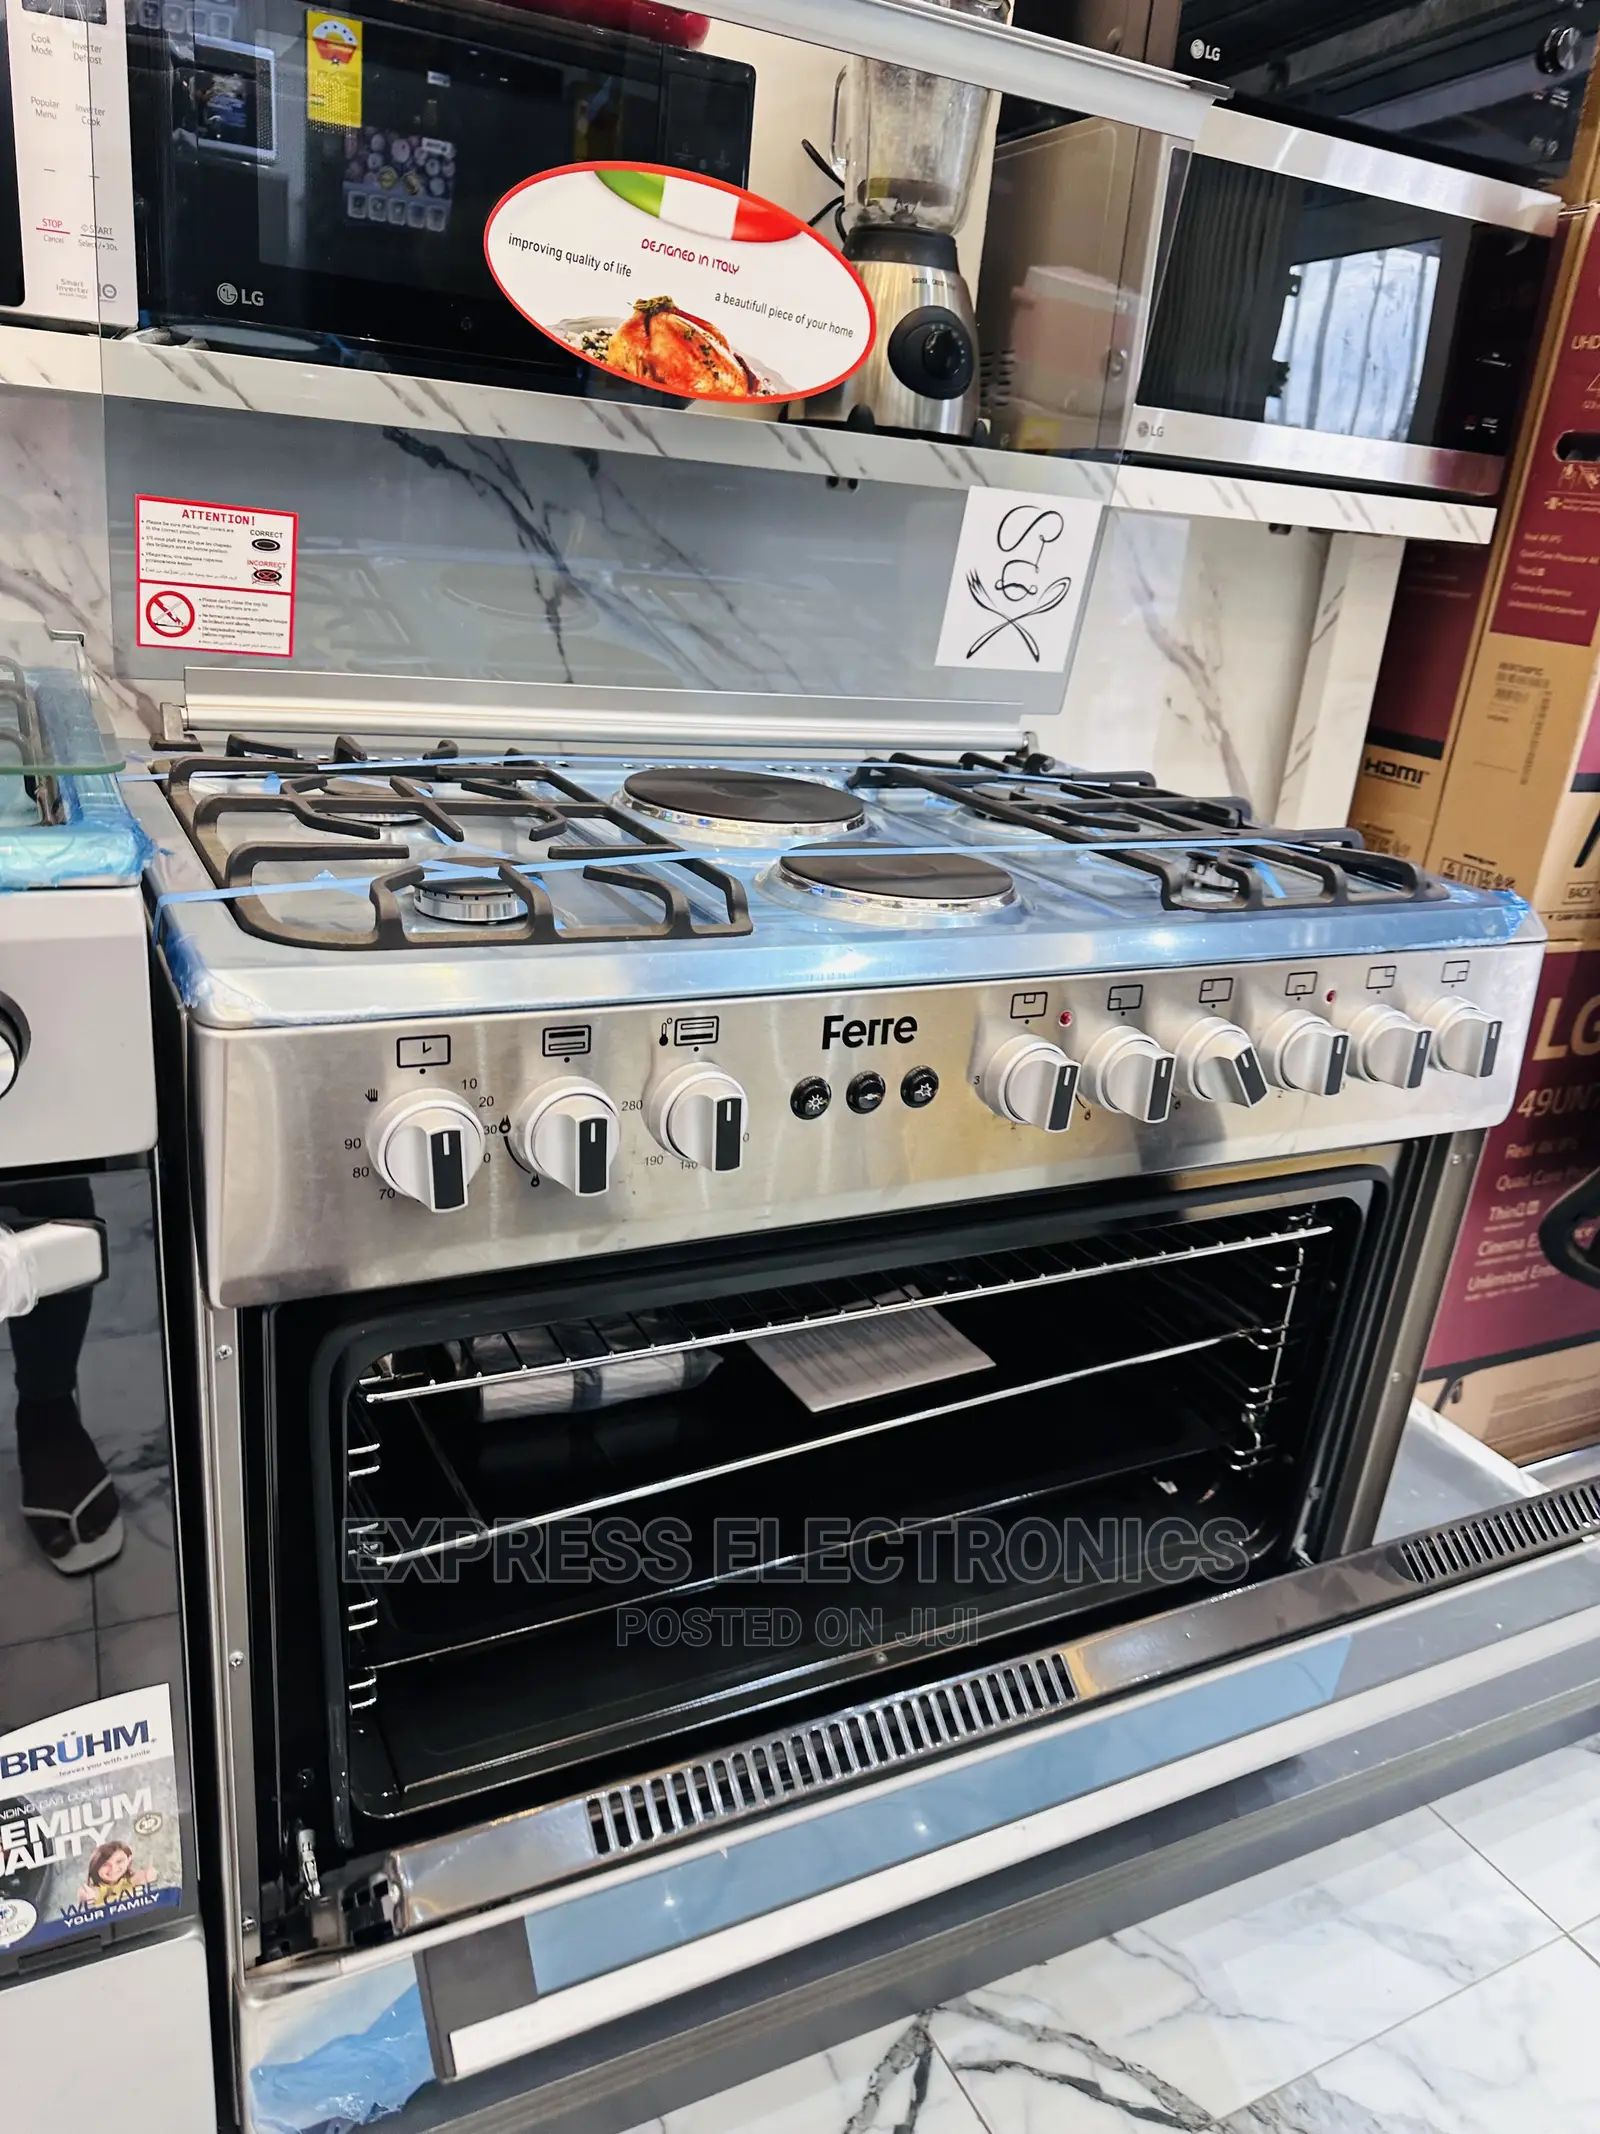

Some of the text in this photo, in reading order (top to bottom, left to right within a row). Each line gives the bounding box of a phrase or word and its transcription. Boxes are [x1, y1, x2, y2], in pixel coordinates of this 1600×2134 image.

[31, 33, 51, 44] Cook
[31, 45, 53, 57] Mode
[72, 40, 102, 53] Inveter
[1205, 45, 1220, 61] LG
[30, 96, 60, 109] Popular
[35, 108, 57, 119] Menu
[75, 104, 105, 116] Inveter
[42, 218, 63, 229] STOP
[43, 234, 64, 244] Cancel
[508, 233, 632, 277] improving quality of life
[641, 239, 695, 262] DESIGNED
[712, 258, 740, 275] ITALY
[60, 278, 84, 287] Smart
[241, 288, 264, 306] LG
[715, 292, 854, 338] a beautifull piece of your home
[1151, 425, 1164, 437] LG
[182, 509, 256, 526] ATTENTION!
[249, 529, 284, 539] CORRECT
[247, 560, 287, 569] INCORRECT
[1364, 757, 1424, 784] HDMI
[821, 1014, 918, 1050] Ferre
[1532, 994, 1600, 1061] LG
[461, 1078, 478, 1090] 10
[478, 1095, 494, 1108] 20
[621, 1099, 643, 1112] 280
[484, 1125, 497, 1135] 30
[344, 1138, 361, 1150] 90
[644, 1154, 664, 1167] 190
[680, 1160, 698, 1170] 140
[352, 1166, 369, 1178] 80
[379, 1188, 396, 1200] 70
[1478, 1239, 1525, 1257] Cinema
[1467, 1265, 1530, 1291] Unlimited
[0, 1720, 149, 1779] BRÜHM
[86, 1762, 102, 1771] you
[103, 1756, 122, 1766] with
[0, 1821, 114, 1877] ALITY
[60, 1898, 97, 1917] WE
[64, 1893, 160, 1928] YOUR FAMILY
